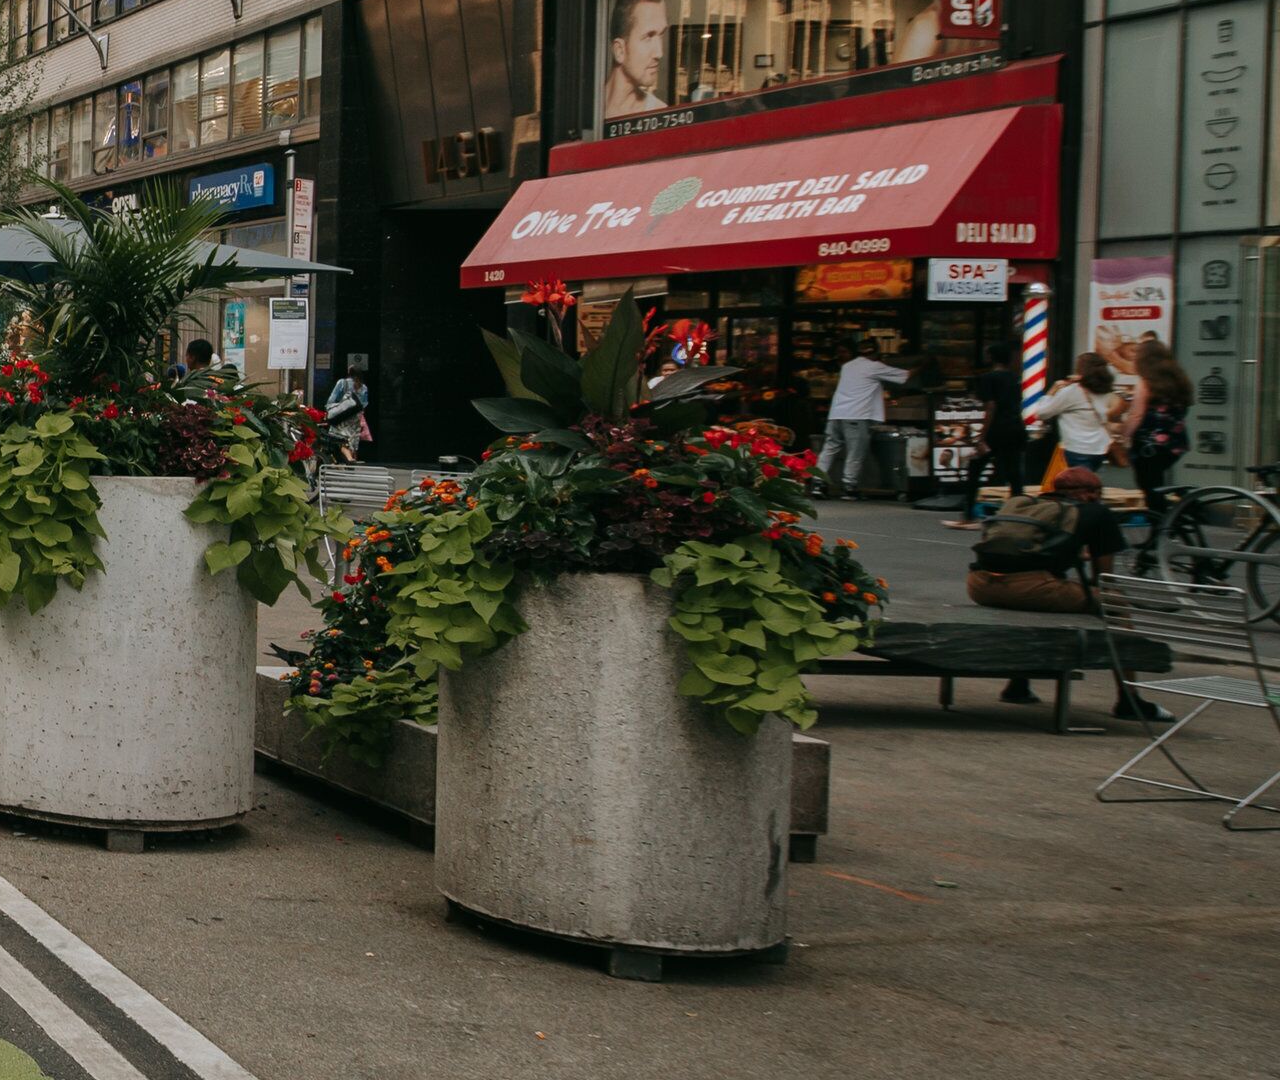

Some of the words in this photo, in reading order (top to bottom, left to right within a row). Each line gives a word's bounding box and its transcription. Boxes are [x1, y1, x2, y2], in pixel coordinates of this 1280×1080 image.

[610, 110, 694, 137] 212-470-7540
[695, 178, 798, 208] GOURMET
[795, 174, 849, 199] DELI
[851, 164, 929, 191] SALAD
[738, 197, 814, 224] HEALTH
[816, 193, 868, 217] BAR
[511, 210, 578, 240] Olive
[575, 201, 642, 237] Tree
[956, 223, 988, 243] DELI
[990, 223, 1036, 244] SALAD
[818, 238, 891, 256] 840-0999
[484, 270, 505, 282] 1420
[948, 264, 985, 280] SPA
[936, 281, 1002, 296] MASSAGE
